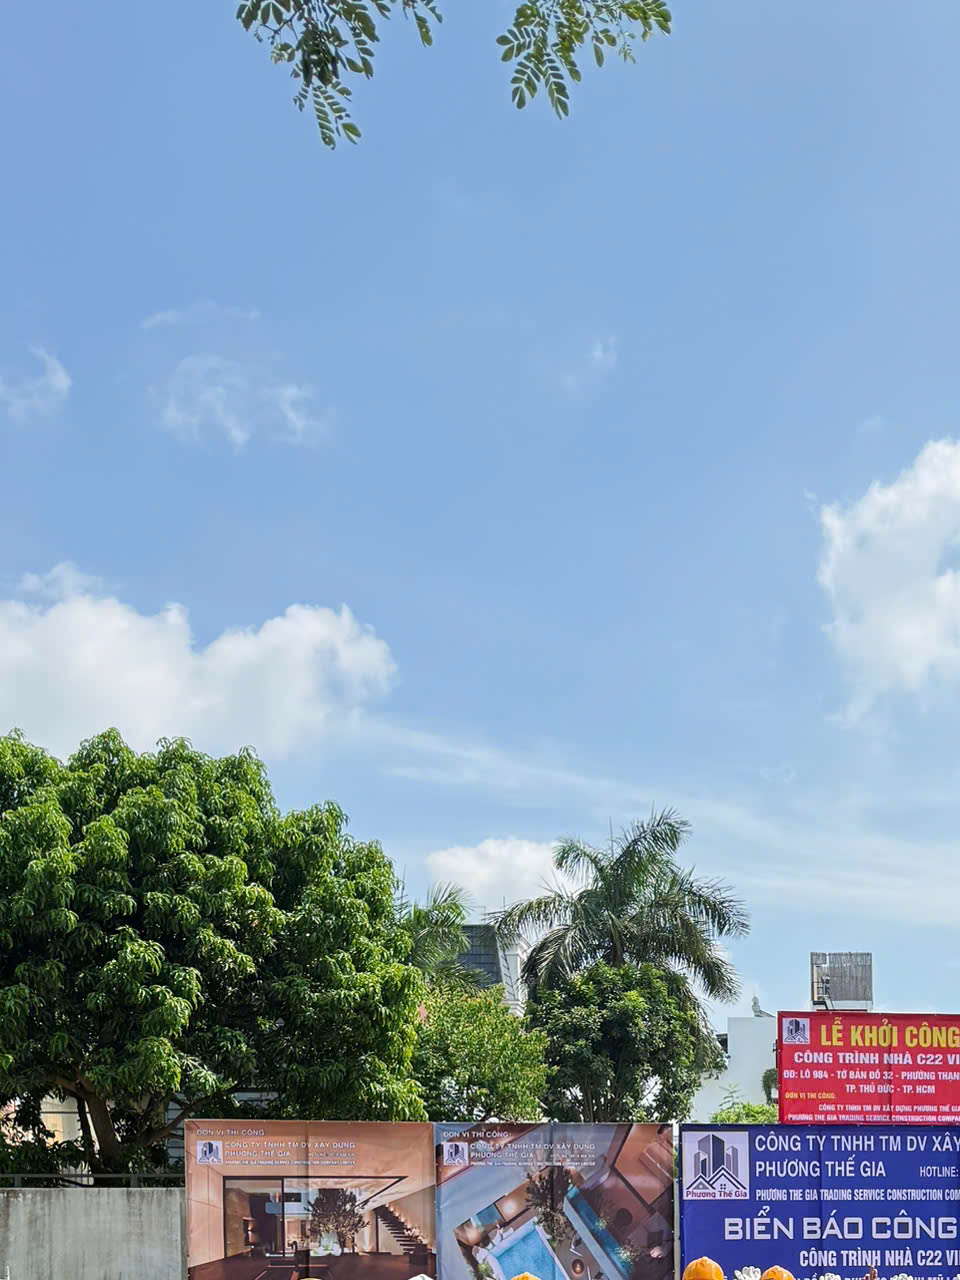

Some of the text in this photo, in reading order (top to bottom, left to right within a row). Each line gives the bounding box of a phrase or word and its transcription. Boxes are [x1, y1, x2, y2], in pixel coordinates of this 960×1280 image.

[821, 1017, 960, 1048] LỄ KHỞI CÔNG
[794, 1050, 833, 1064] CÔNG
[837, 1051, 879, 1064] TRÌNH
[884, 1051, 912, 1065] NHÀ
[917, 1053, 943, 1065] C22
[813, 1070, 828, 1079] 984
[883, 1071, 894, 1080] 32
[846, 1084, 857, 1094] TP.
[902, 1085, 914, 1094] TP.
[916, 1085, 936, 1094] HCM
[755, 1130, 801, 1152] CÔNG
[806, 1135, 826, 1151] TY
[831, 1135, 874, 1151] TNHH
[879, 1135, 902, 1151] TM
[907, 1135, 928, 1152] DV
[755, 1153, 886, 1178] PHƯƠNG THẾ GIA
[919, 1166, 959, 1178] HOTLINE:
[734, 1190, 748, 1198] Gia
[789, 1188, 804, 1201] THE
[805, 1188, 818, 1201] GIA
[820, 1188, 852, 1201] TRADING
[853, 1188, 885, 1201] SERVICE
[886, 1188, 943, 1201] CONSTRUCTION
[724, 1205, 794, 1240] BIỂN
[803, 1209, 863, 1240] BÁO
[871, 1209, 957, 1240] CÔNG
[799, 1247, 837, 1267] CÔNG
[840, 1246, 881, 1266] TRÌNH
[885, 1246, 914, 1266] NHÀ
[917, 1249, 943, 1266] C22
